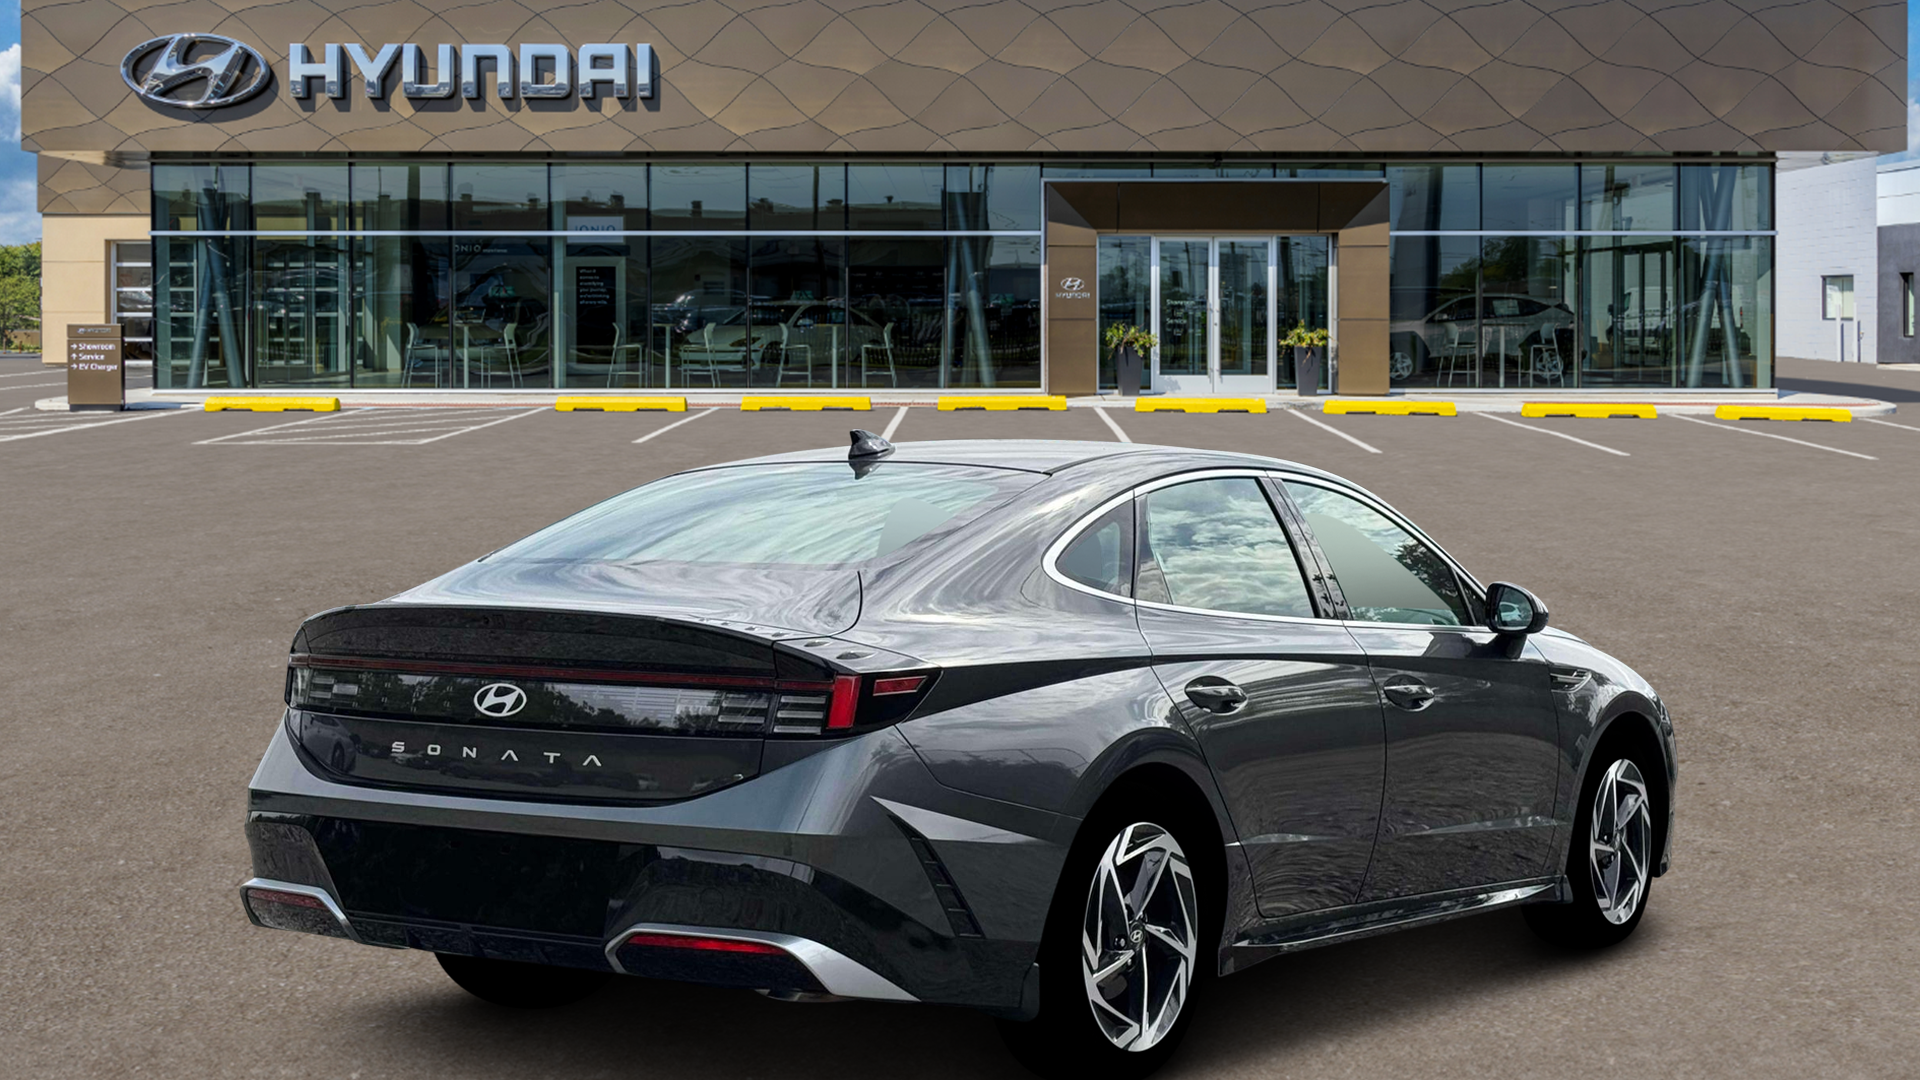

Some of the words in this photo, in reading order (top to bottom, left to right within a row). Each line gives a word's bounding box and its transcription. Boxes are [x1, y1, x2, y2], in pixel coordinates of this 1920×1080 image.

[289, 43, 653, 98] HYUNDAI
[78, 352, 105, 360] Service
[90, 363, 118, 372] Charger
[391, 741, 602, 767] SONATA
